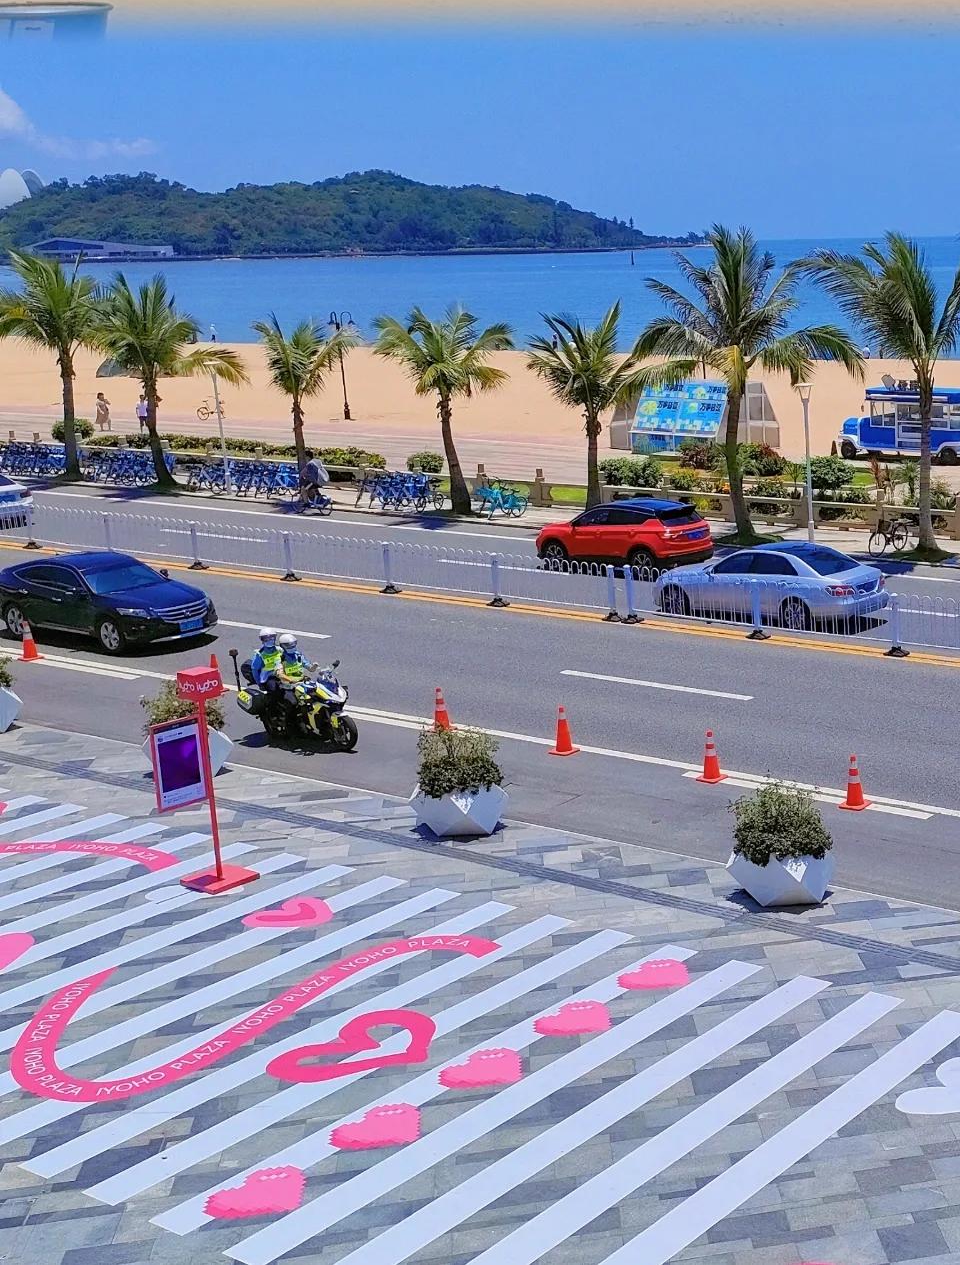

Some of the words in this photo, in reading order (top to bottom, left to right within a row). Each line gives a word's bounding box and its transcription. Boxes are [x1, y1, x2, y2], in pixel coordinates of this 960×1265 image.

[5, 843, 57, 851] PLAZA
[68, 844, 118, 852] IYOHO
[120, 847, 158, 862] PLAZA
[408, 938, 471, 948] PLAZA
[339, 946, 397, 972] IYOHO
[51, 982, 91, 1012] IYOHO
[283, 974, 335, 1003] PLAZA
[30, 1012, 60, 1043] PLAZA
[232, 1004, 283, 1035] IYOHO
[23, 1047, 44, 1075] IYOHO
[170, 1038, 231, 1071] PLAZA
[38, 1074, 83, 1096] PLAZA
[96, 1071, 166, 1096] IYOHO
